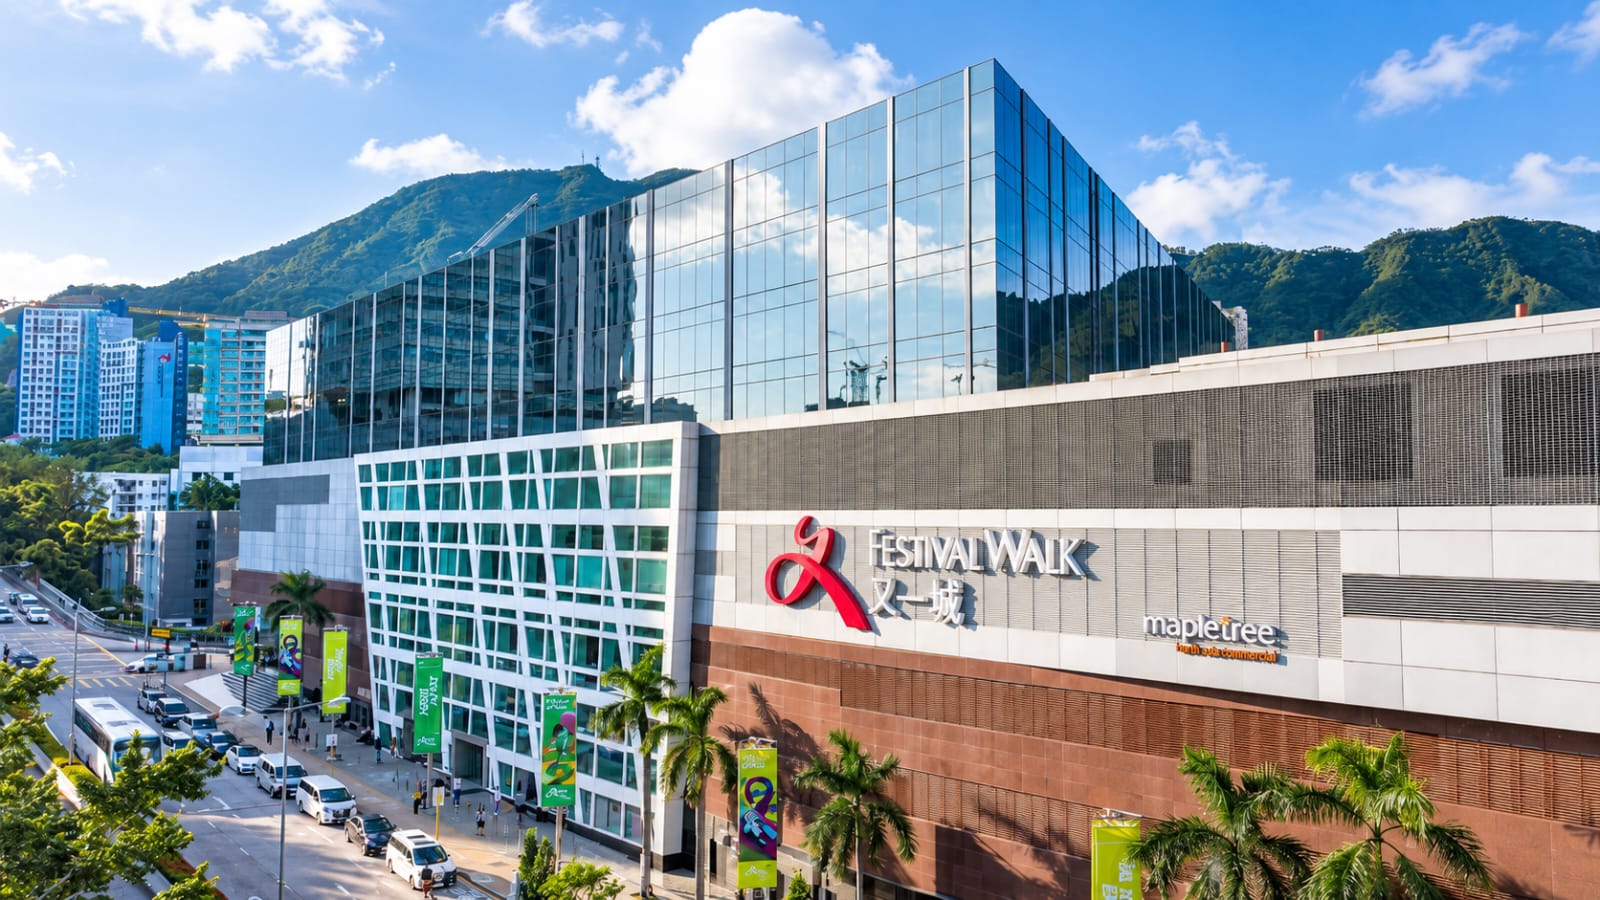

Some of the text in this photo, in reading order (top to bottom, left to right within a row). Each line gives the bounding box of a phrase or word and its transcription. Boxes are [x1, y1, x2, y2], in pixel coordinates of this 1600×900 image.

[869, 528, 1086, 576] FESTIVAL WALK
[868, 577, 966, 625] 又一城
[1143, 614, 1275, 645] mapletree
[1221, 648, 1277, 663] commercial
